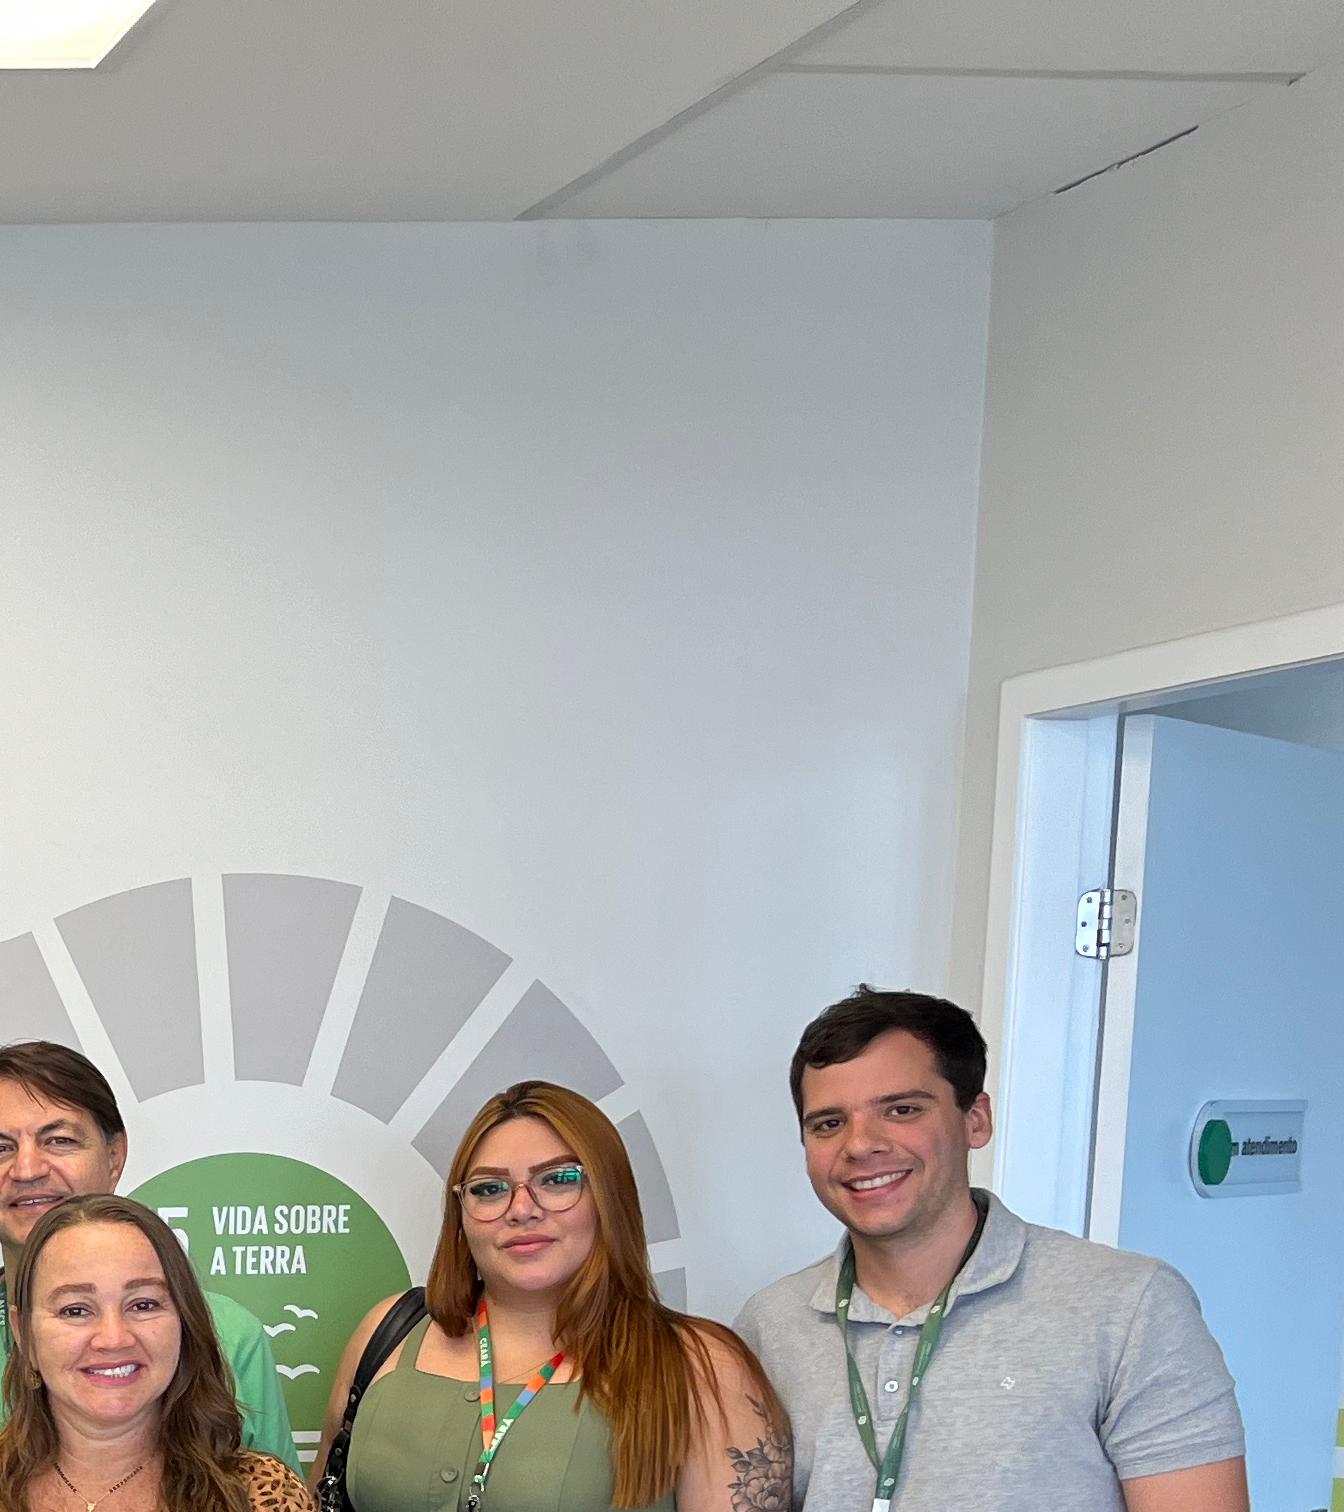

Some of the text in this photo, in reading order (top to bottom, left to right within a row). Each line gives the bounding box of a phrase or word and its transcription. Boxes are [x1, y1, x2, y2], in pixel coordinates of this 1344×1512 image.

[212, 1204, 351, 1235] VIDA SOBRE
[210, 1245, 307, 1275] A TERRA
